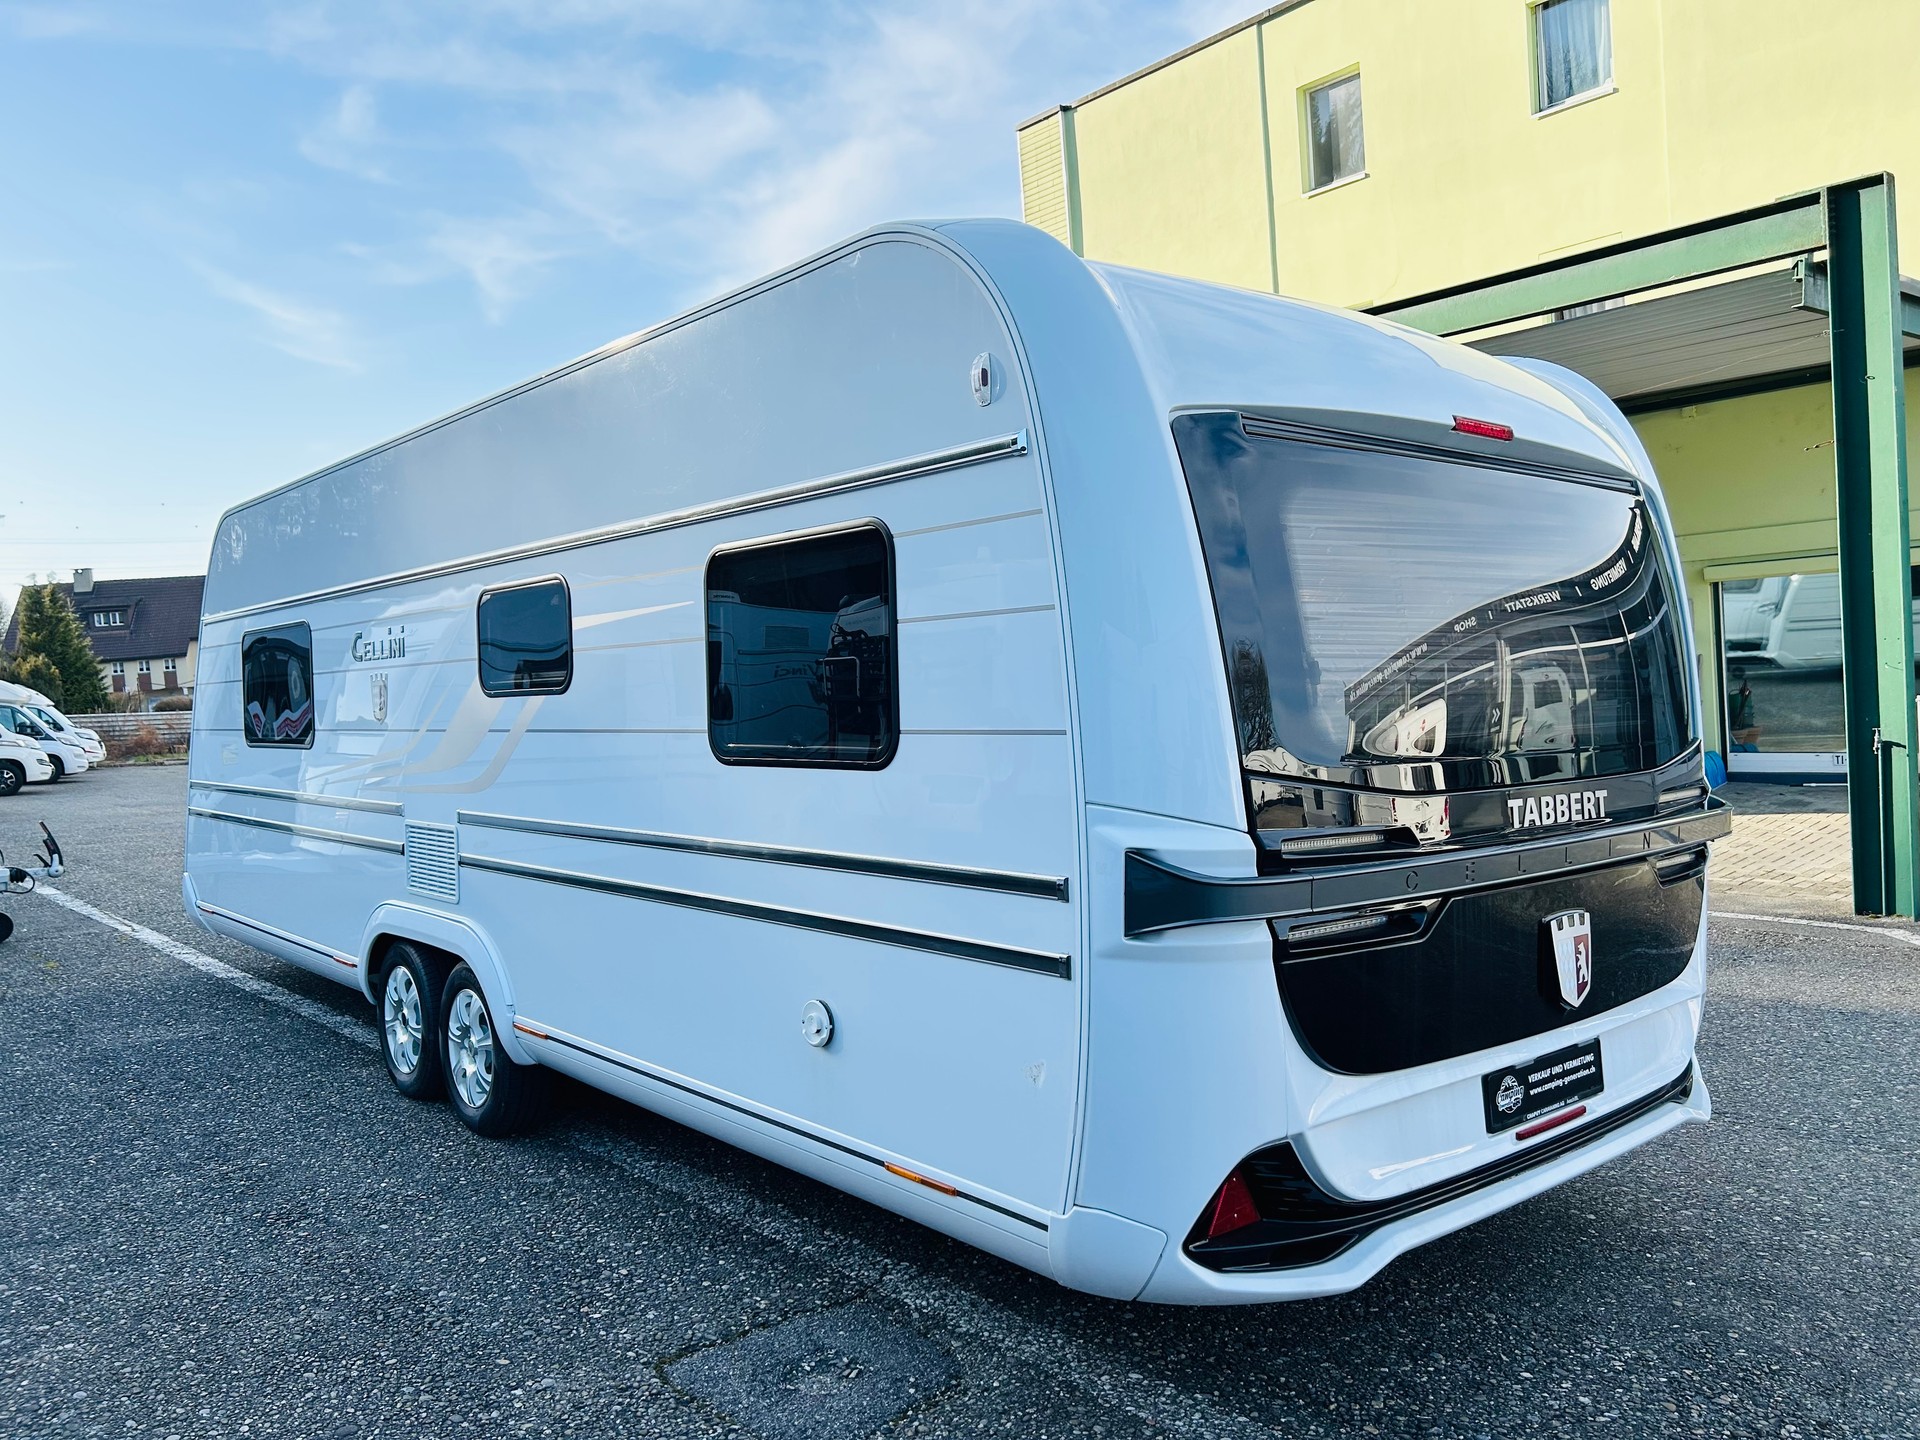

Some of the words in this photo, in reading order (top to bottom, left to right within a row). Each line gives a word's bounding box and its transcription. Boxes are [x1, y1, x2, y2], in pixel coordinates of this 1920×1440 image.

[1507, 789, 1609, 829] TABBERT
[1405, 825, 1681, 892] CELLINI
[1527, 1068, 1551, 1083] VERKAUF
[1551, 1064, 1563, 1075] UND
[1563, 1052, 1595, 1071] VERMIETUNG
